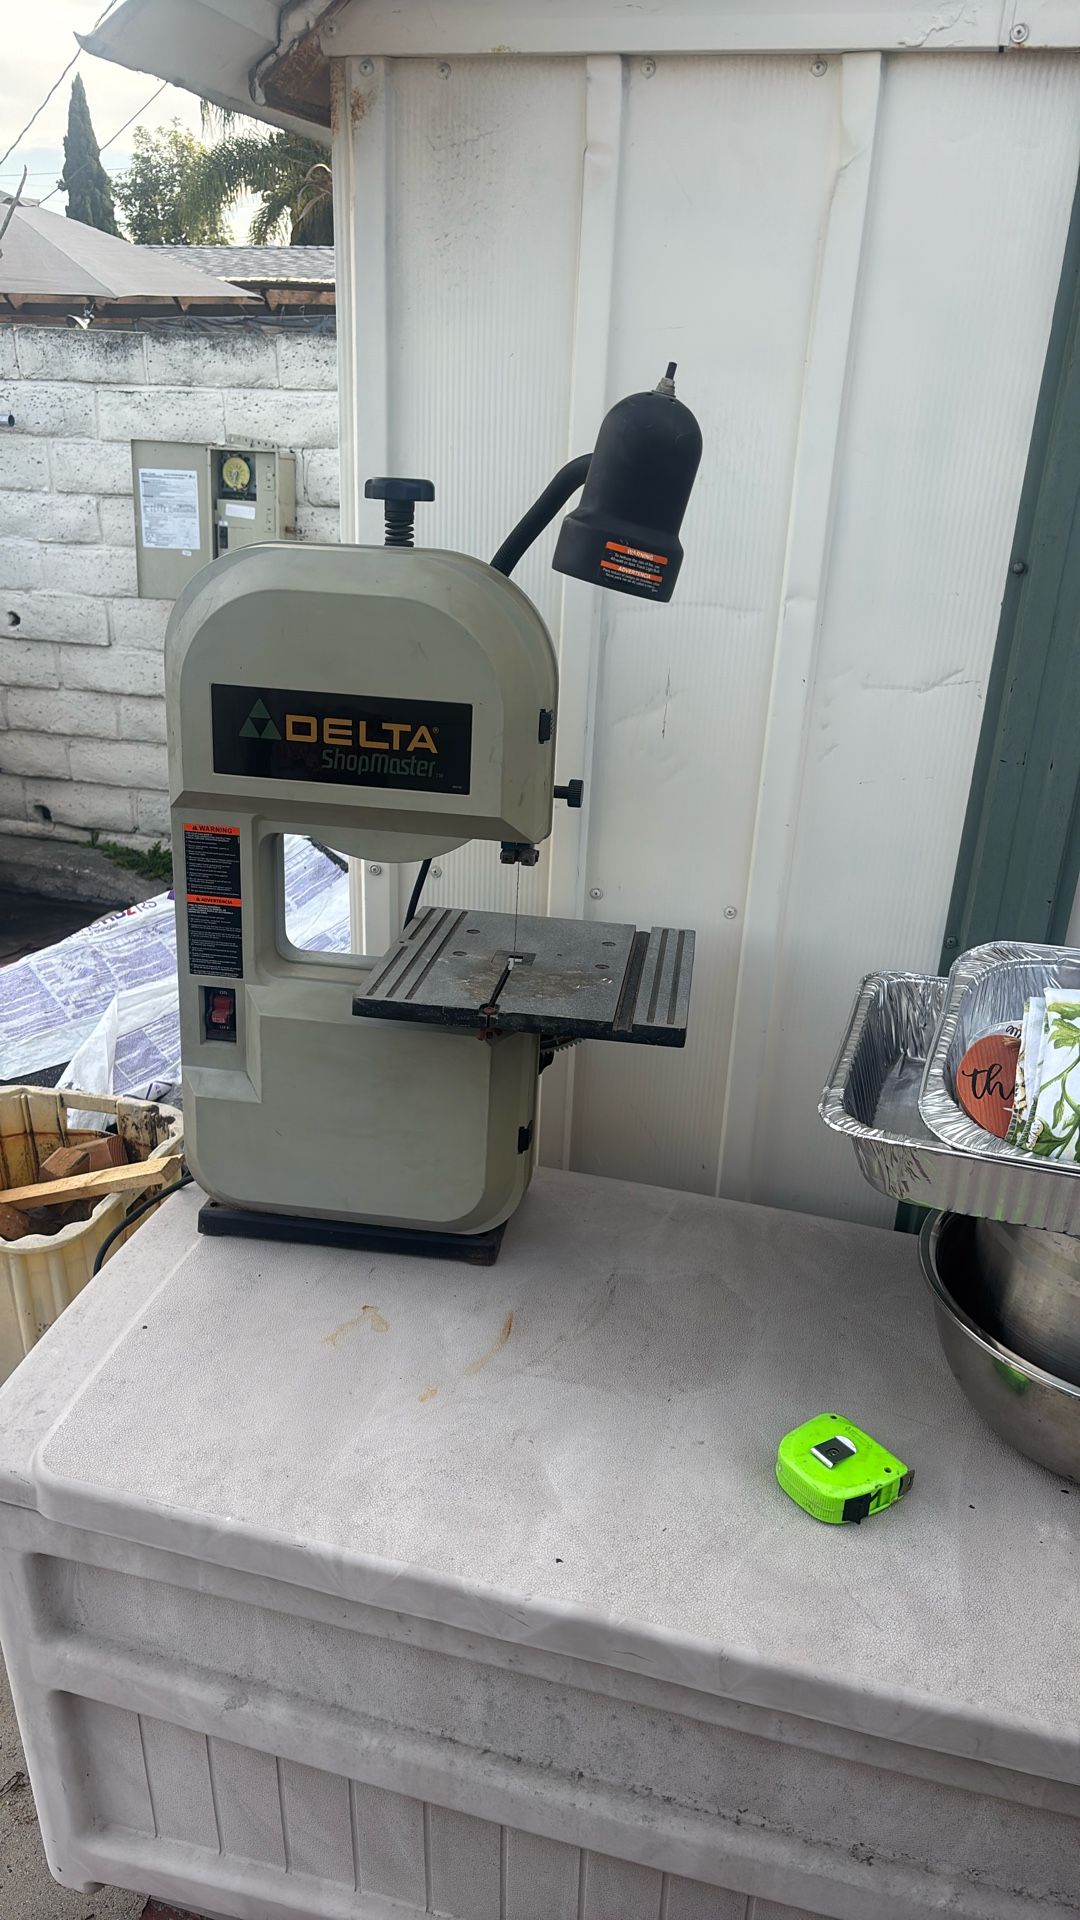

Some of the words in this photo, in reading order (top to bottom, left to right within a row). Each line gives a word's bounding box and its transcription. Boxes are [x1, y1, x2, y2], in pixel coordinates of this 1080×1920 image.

[627, 548, 654, 561] WARNING
[618, 566, 651, 579] ADVERTENCIA
[321, 748, 436, 778] ShopMaster
[199, 825, 233, 834] WARNING
[201, 897, 233, 905] ADVERTENCIA
